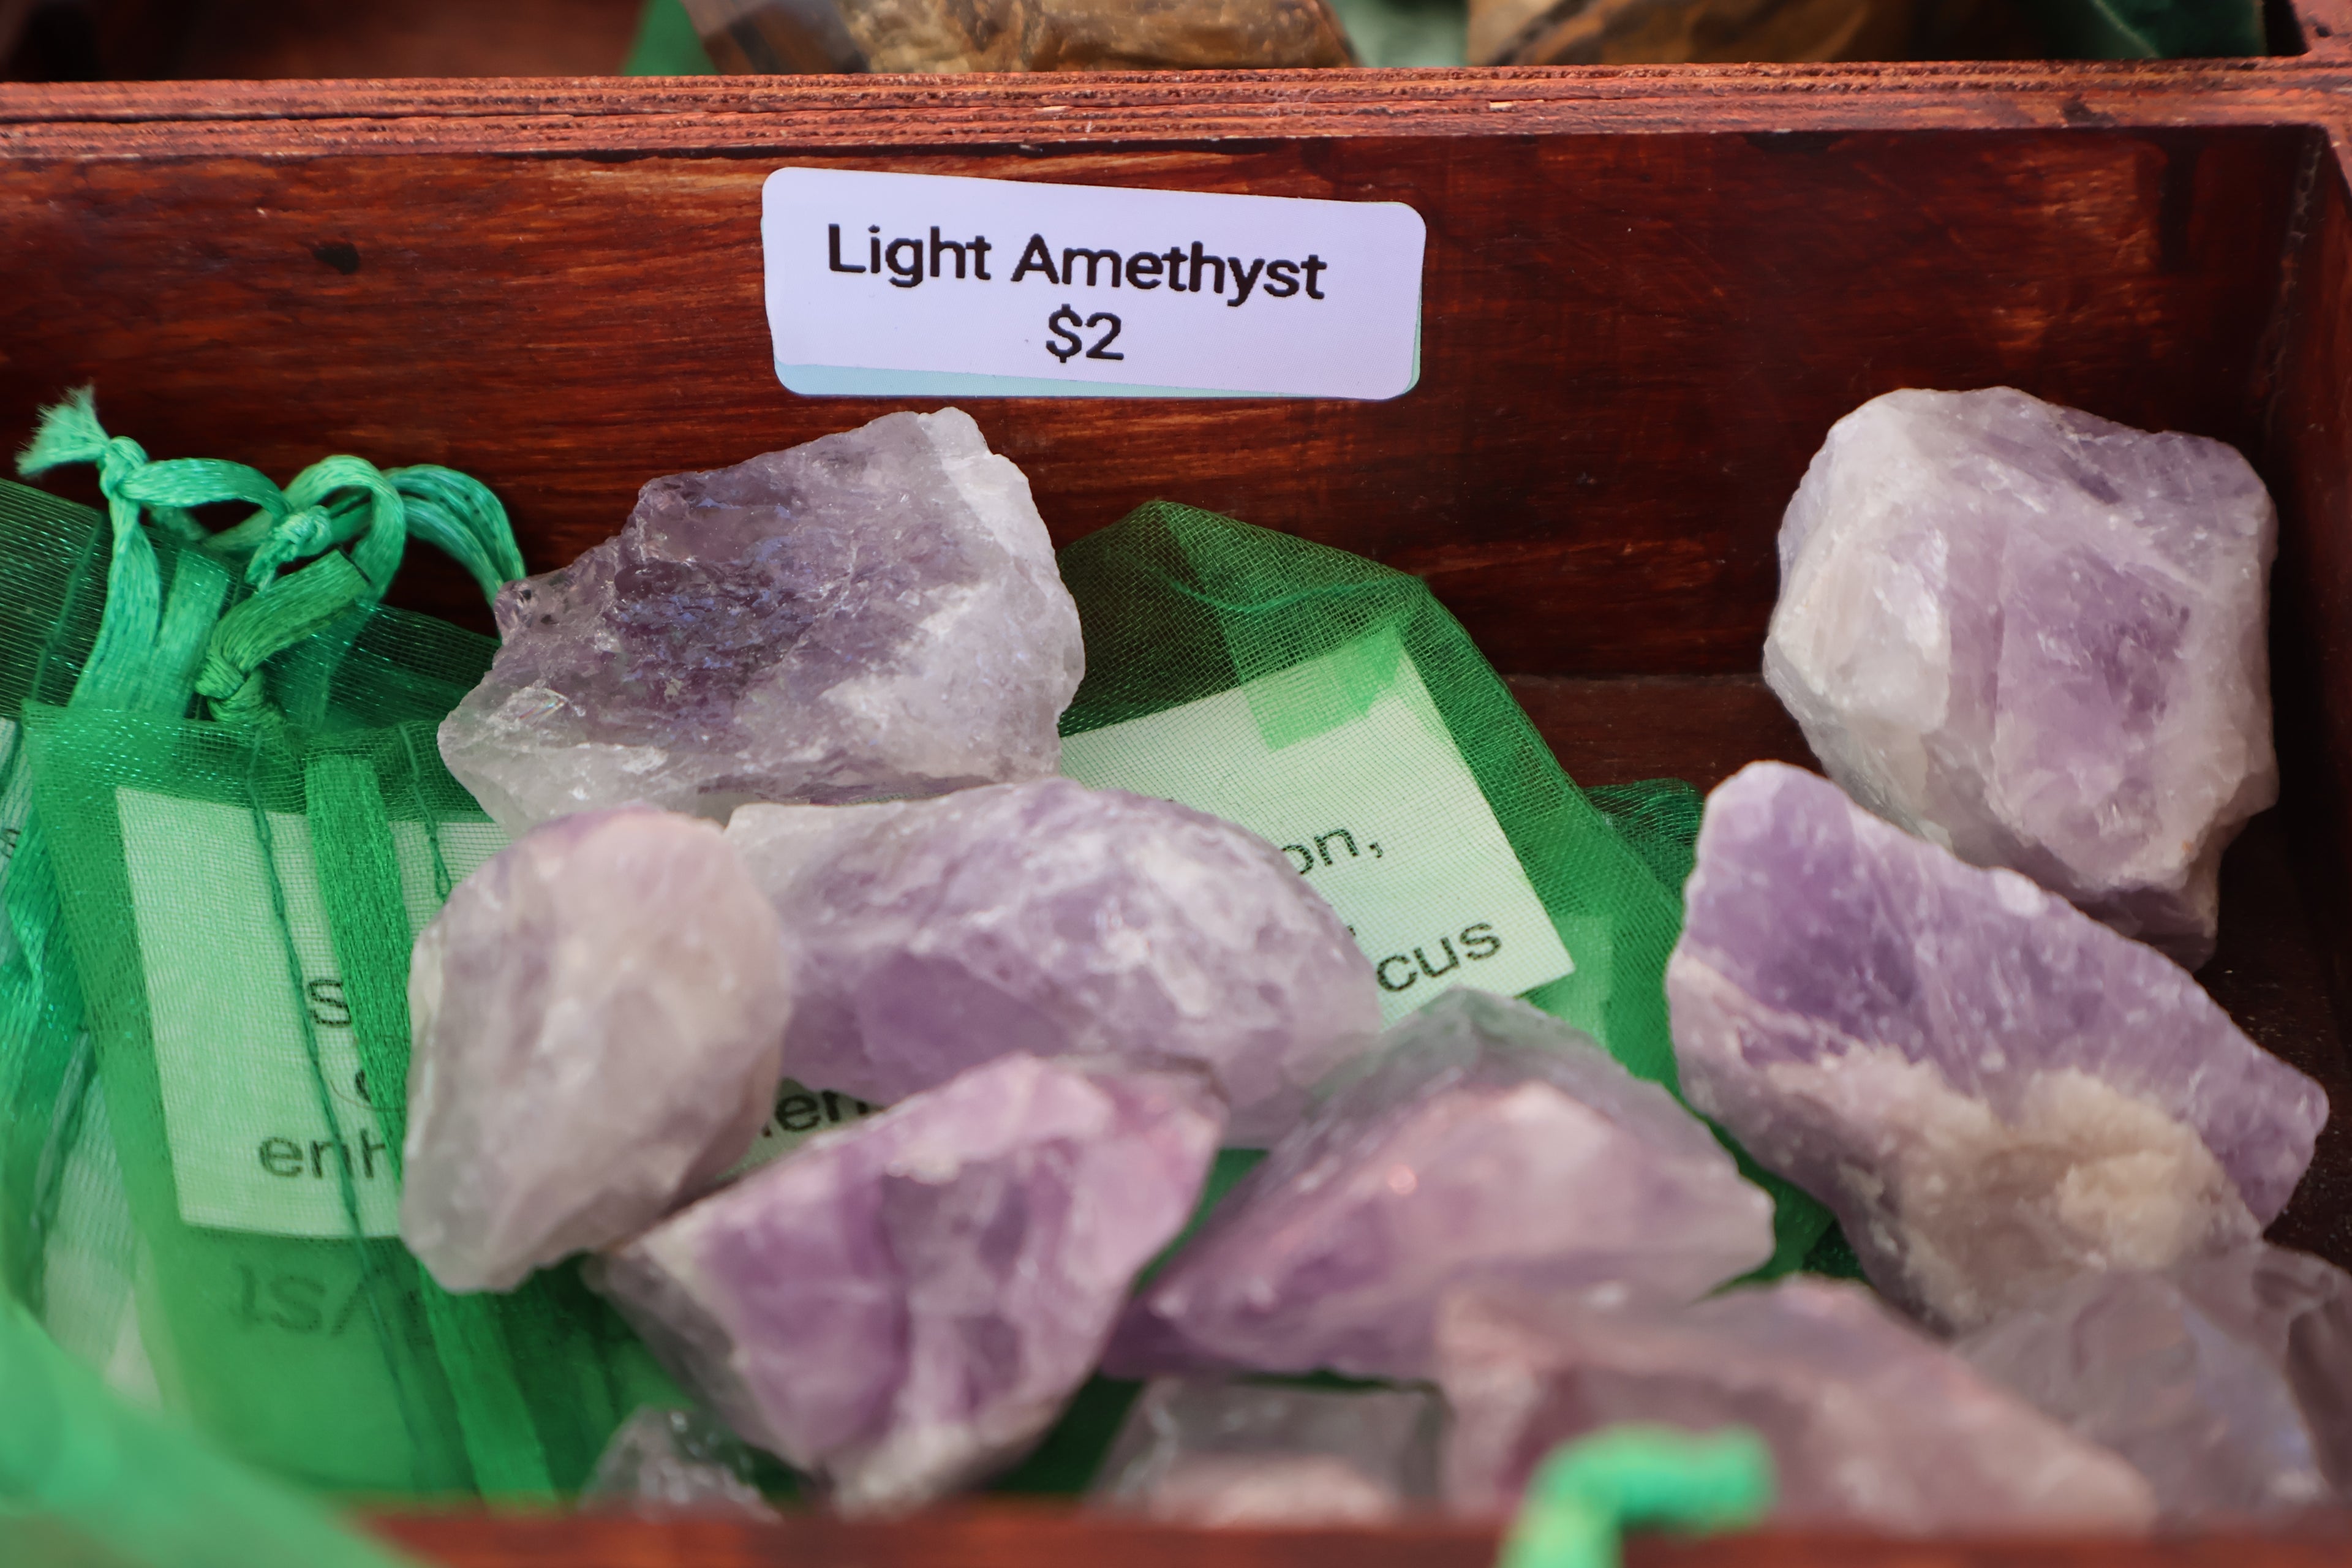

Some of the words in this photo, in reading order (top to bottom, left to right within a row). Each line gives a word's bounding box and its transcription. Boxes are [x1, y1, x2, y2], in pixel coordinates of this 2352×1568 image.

[828, 224, 992, 288] Light
[1011, 233, 1327, 307] Amethyst
[1046, 304, 1125, 364] $2
[1377, 922, 1501, 992] cus
